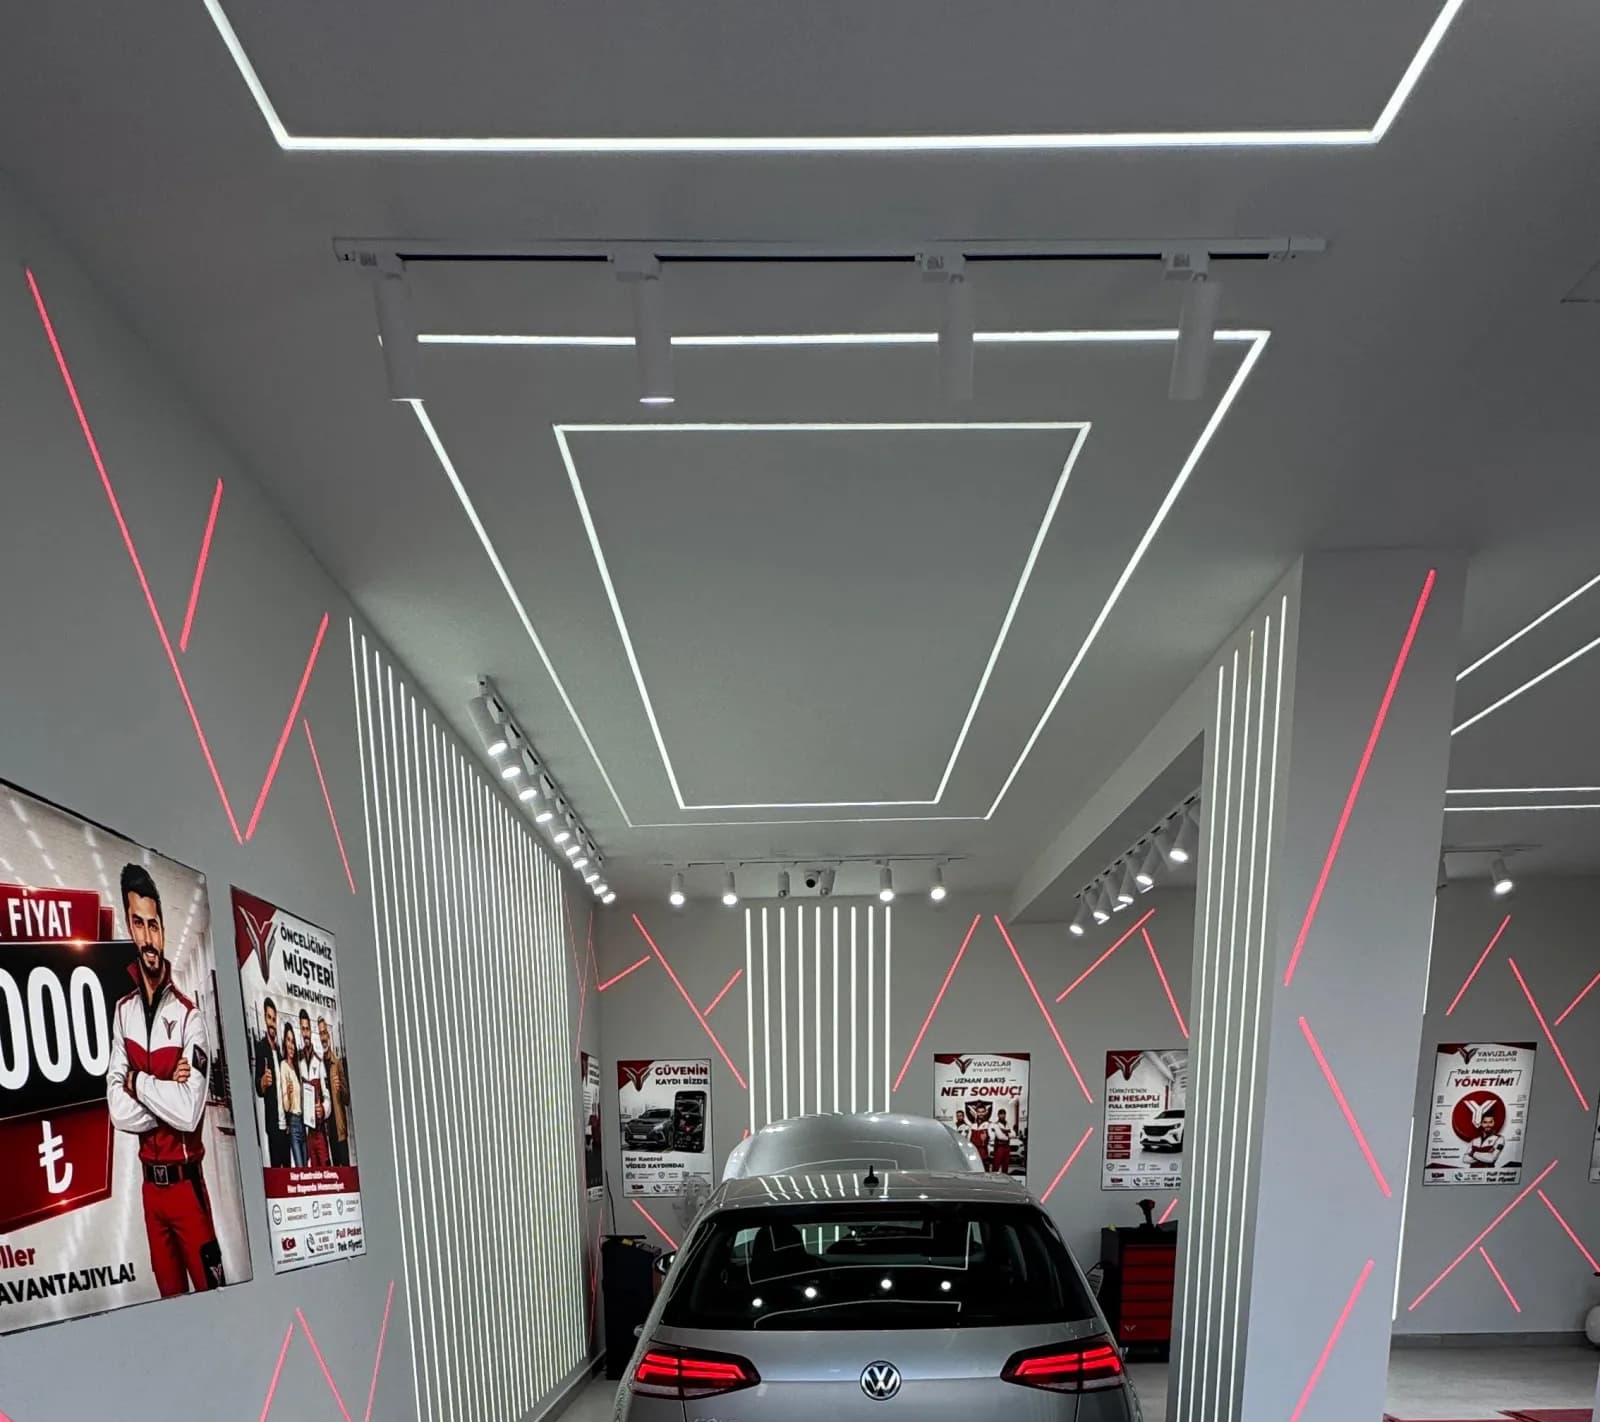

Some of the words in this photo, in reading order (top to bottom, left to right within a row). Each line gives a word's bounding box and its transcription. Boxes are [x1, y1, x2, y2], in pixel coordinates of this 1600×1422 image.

[8, 889, 72, 937] FİYAT
[280, 922, 333, 961] ÖNCELİĞİMİZ
[282, 948, 335, 989] MÜŞTERİ
[286, 981, 337, 1011] MEMNUNİYETİ
[655, 1064, 708, 1076] GÜVENİN
[683, 1076, 709, 1085] BİZDE
[983, 1076, 1006, 1084] BAKIŞ
[1454, 1074, 1515, 1088] YÖNETİM!
[941, 1086, 969, 1097] NET
[970, 1085, 1024, 1099] SONUÇ!
[1123, 1094, 1160, 1102] HESAPLI
[0, 1245, 35, 1269] ller
[0, 1262, 136, 1306] AVANTAJIYLA!
